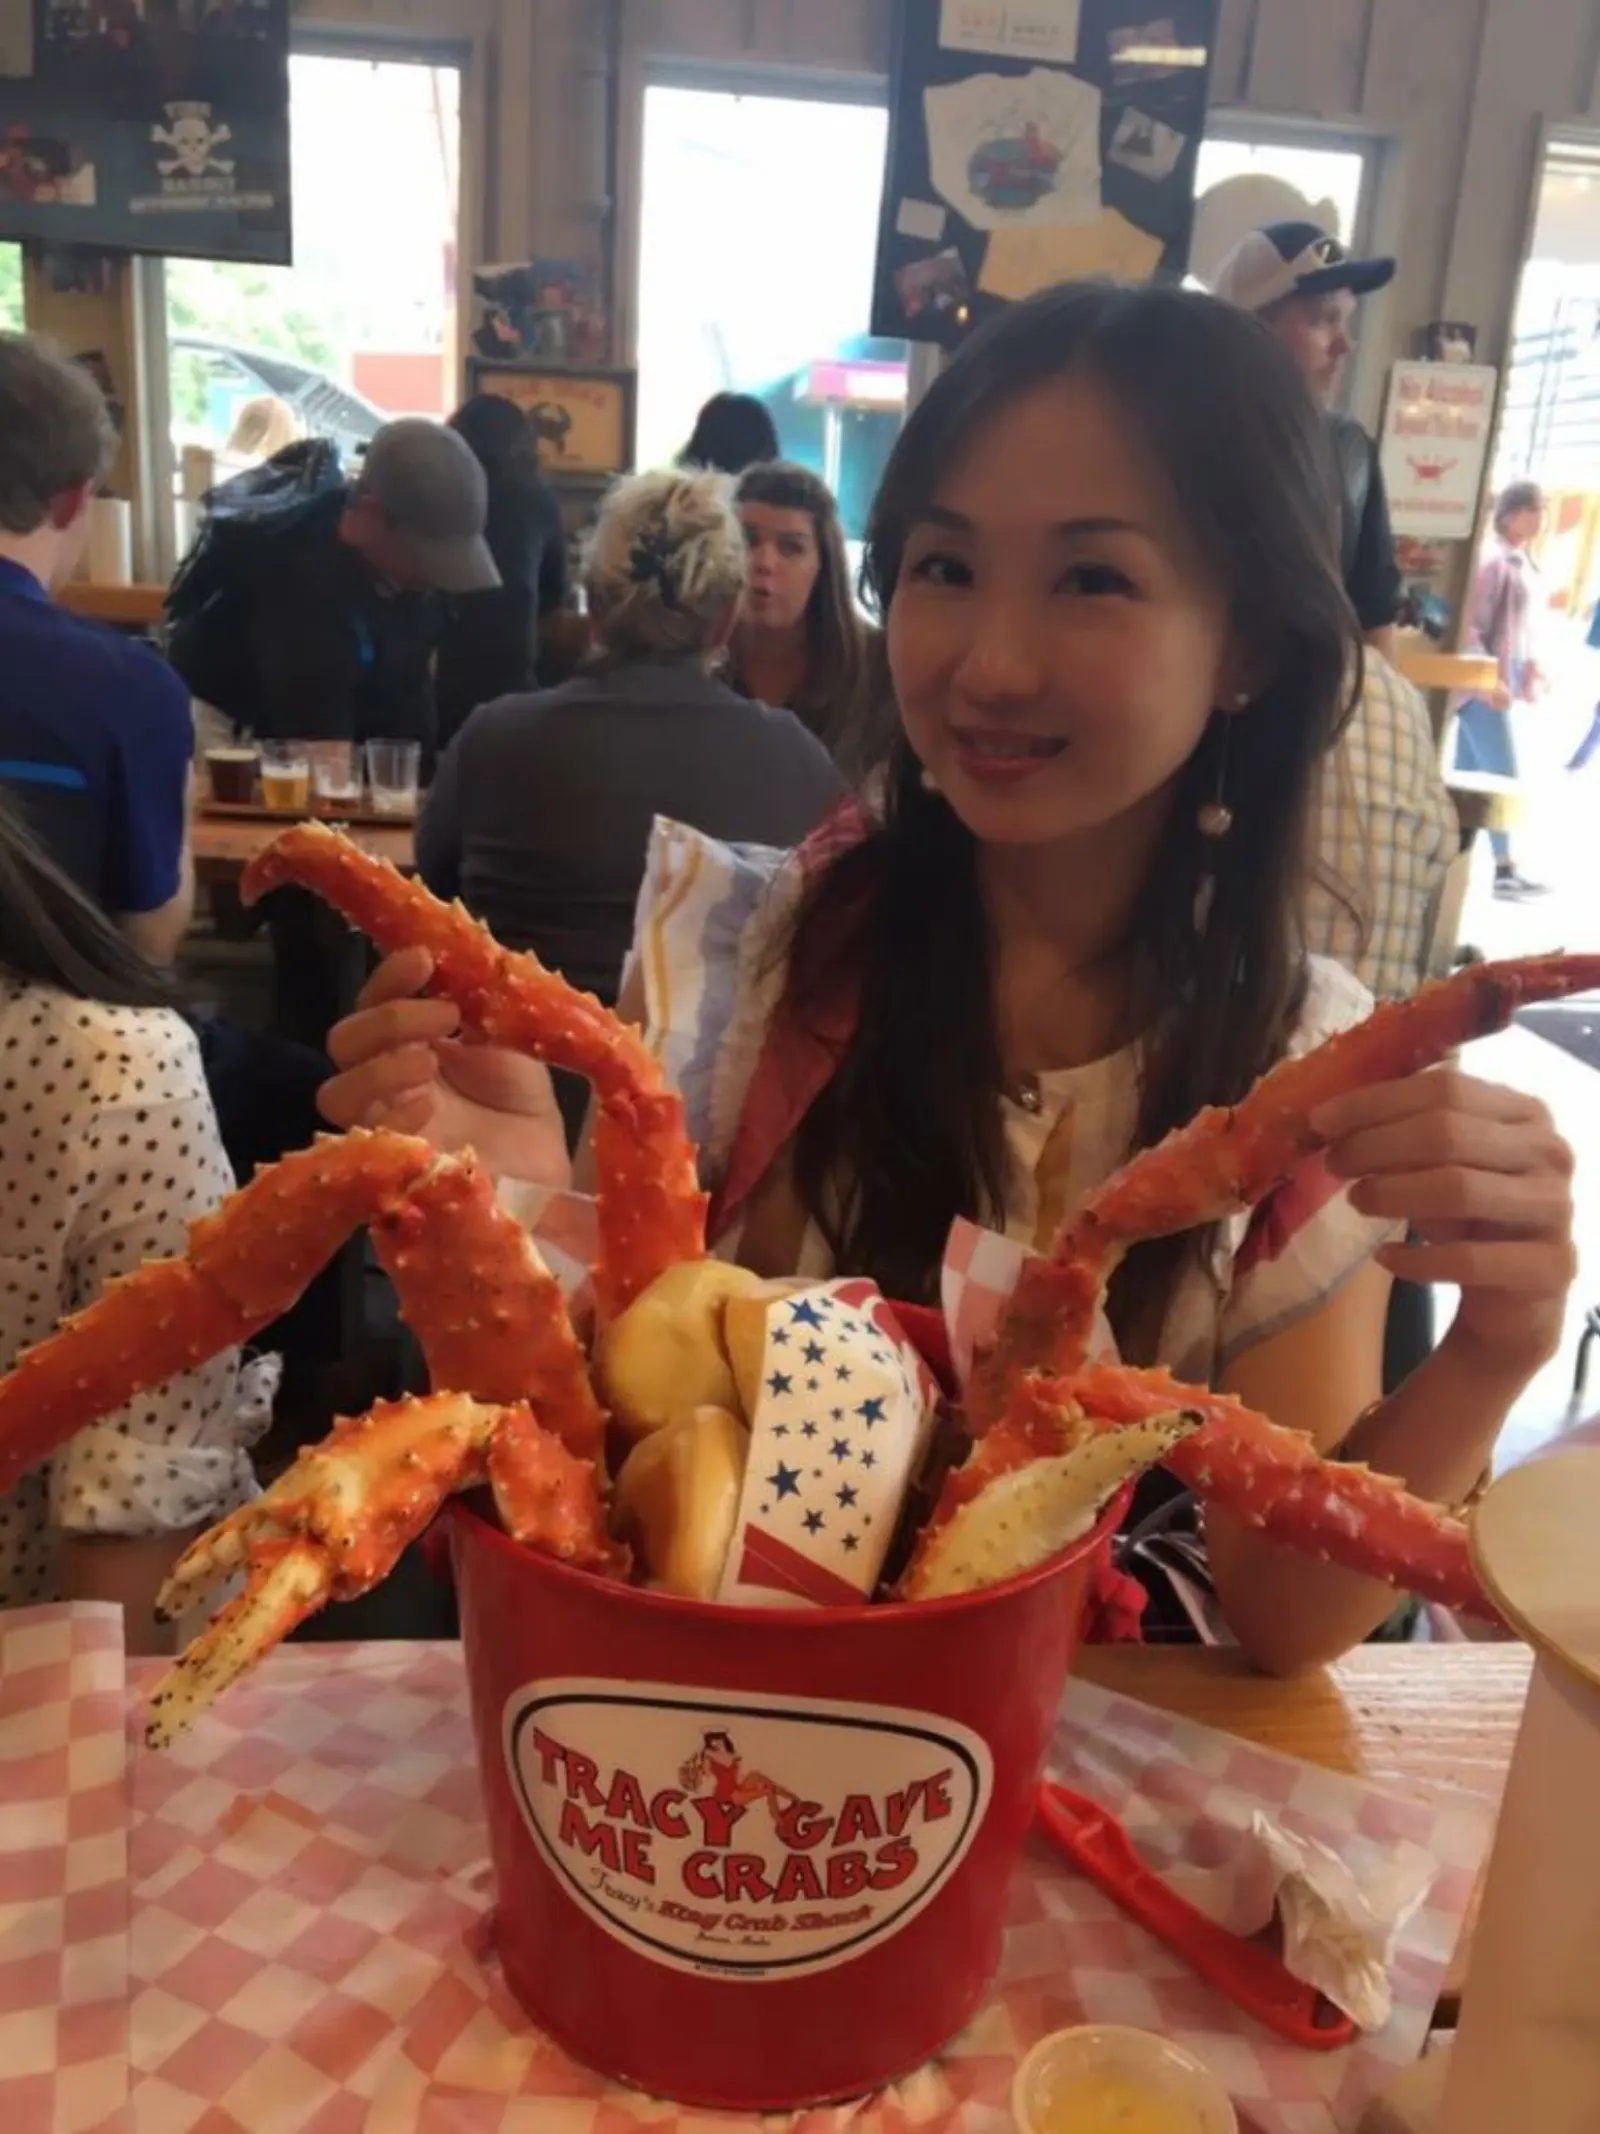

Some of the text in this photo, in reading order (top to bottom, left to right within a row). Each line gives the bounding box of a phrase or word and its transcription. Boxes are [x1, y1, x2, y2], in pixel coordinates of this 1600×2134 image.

[533, 1727, 953, 1851] TRACY GAVE
[558, 1803, 920, 1904] ME CRABS
